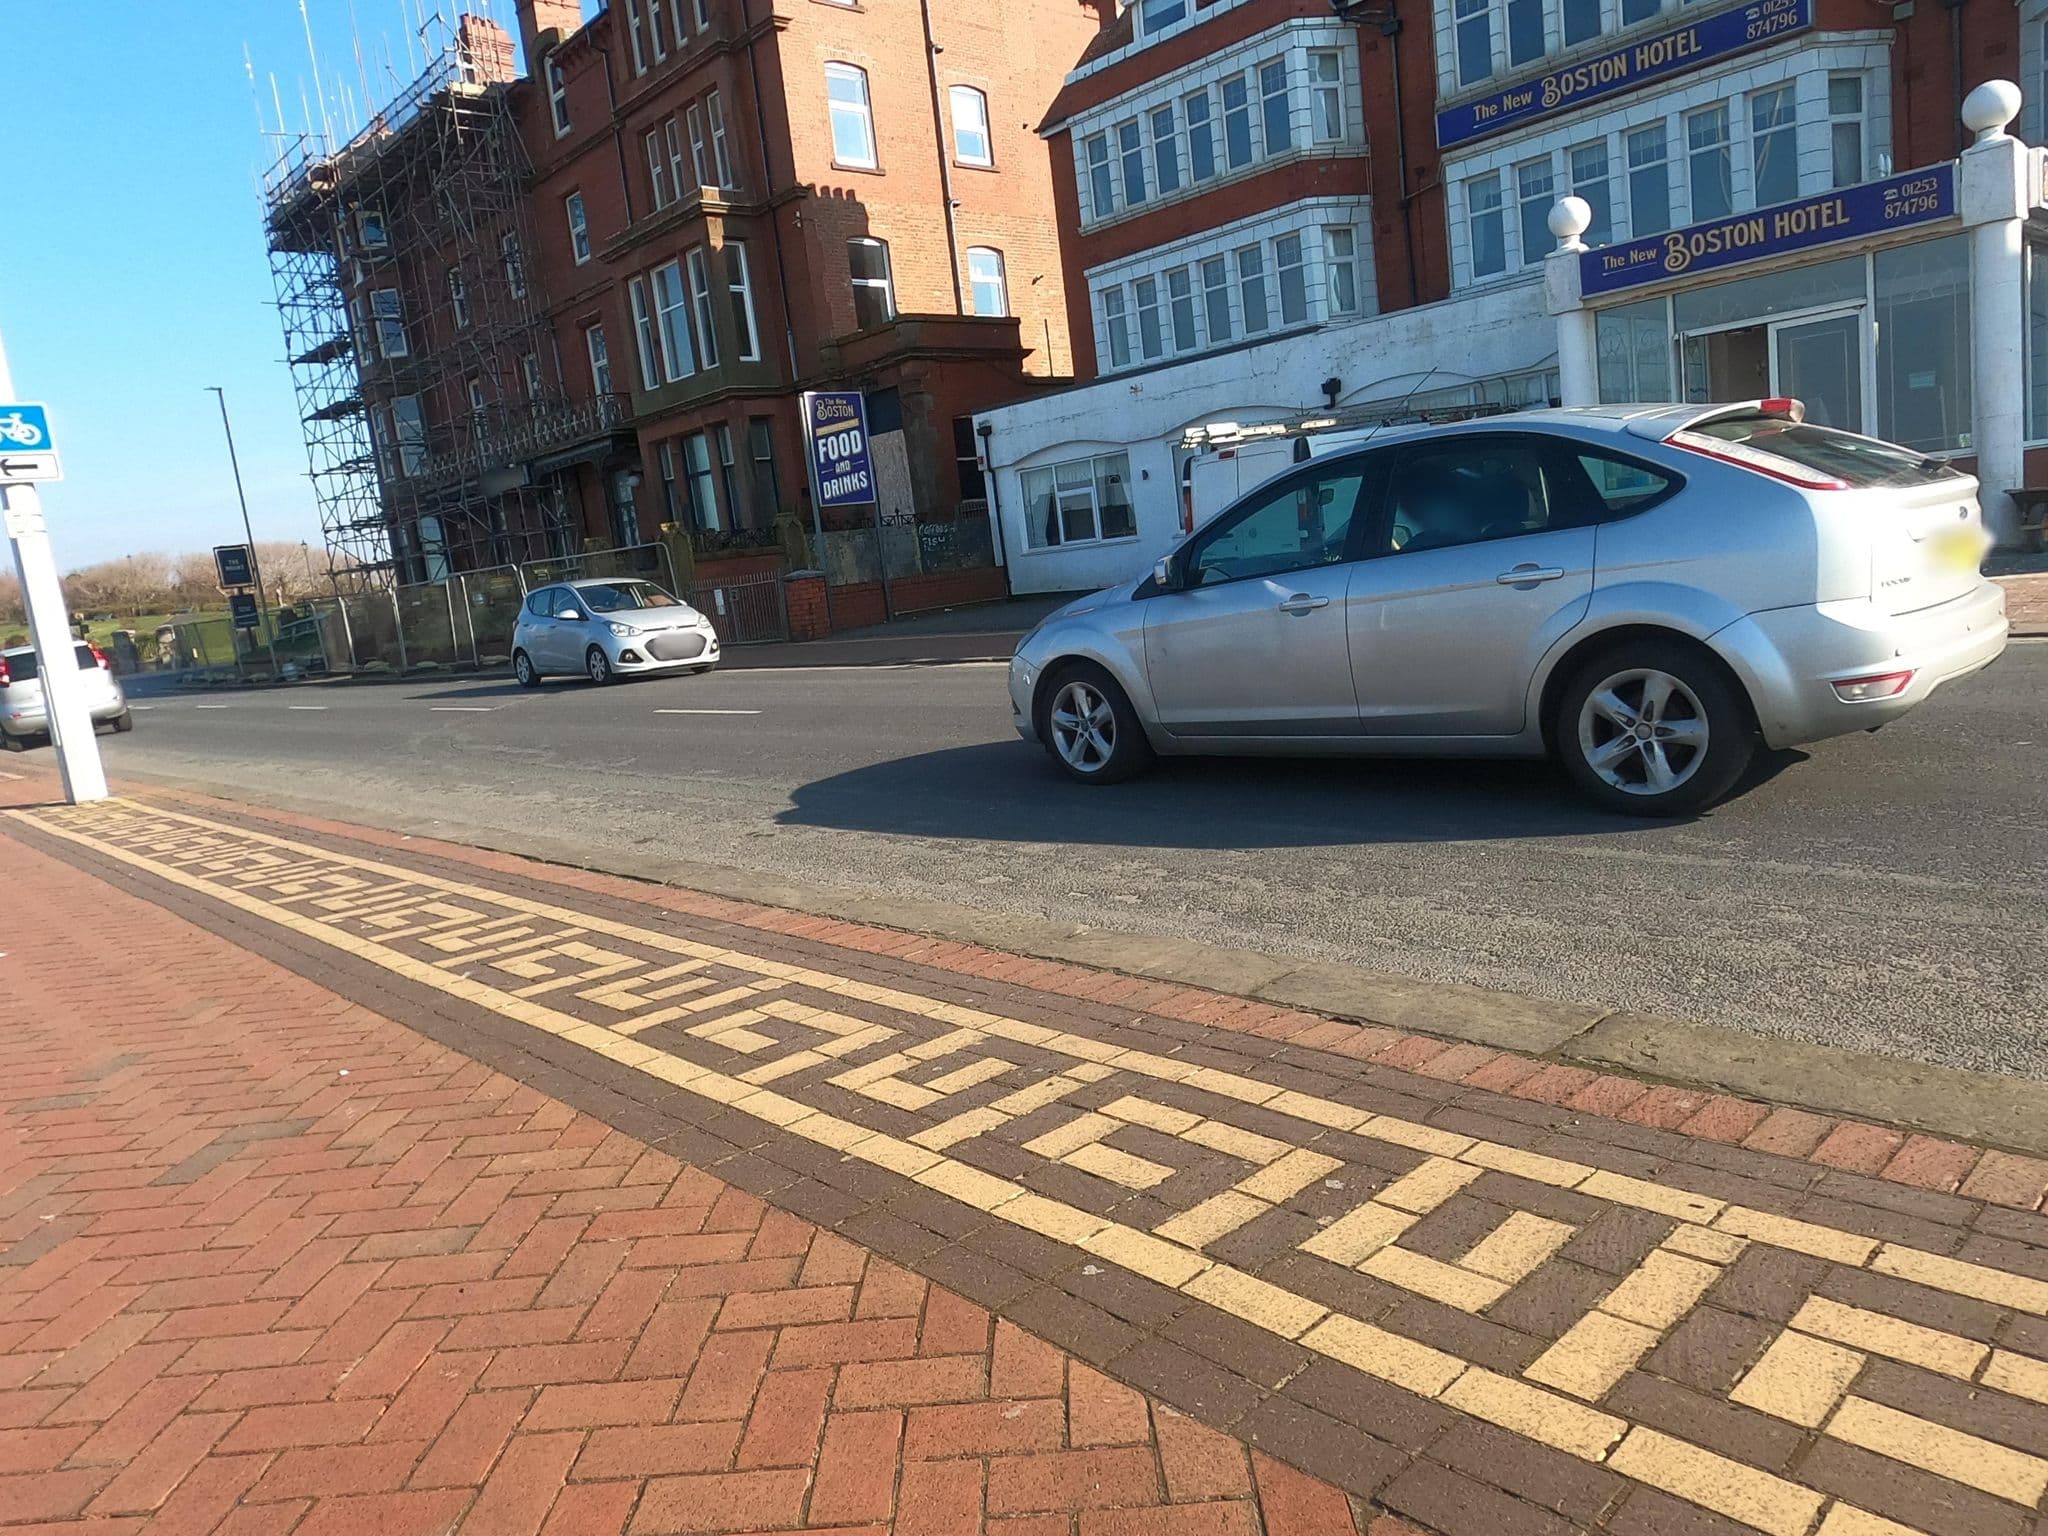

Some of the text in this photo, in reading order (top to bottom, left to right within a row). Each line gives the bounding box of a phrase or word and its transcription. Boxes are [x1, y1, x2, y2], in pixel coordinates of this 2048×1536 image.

[1746, 8, 1798, 39] 874796
[1473, 103, 1498, 121] The
[1503, 90, 1534, 112] New
[1635, 29, 1702, 71] HOTEL
[1902, 177, 1937, 197] 01253
[1884, 193, 1938, 219] 874796
[1602, 254, 1625, 271] The
[1630, 247, 1657, 265] New
[1774, 199, 1849, 239] HOTEL
[817, 430, 862, 464] FOOD
[835, 460, 851, 474] AND
[823, 471, 868, 500] DRINKS
